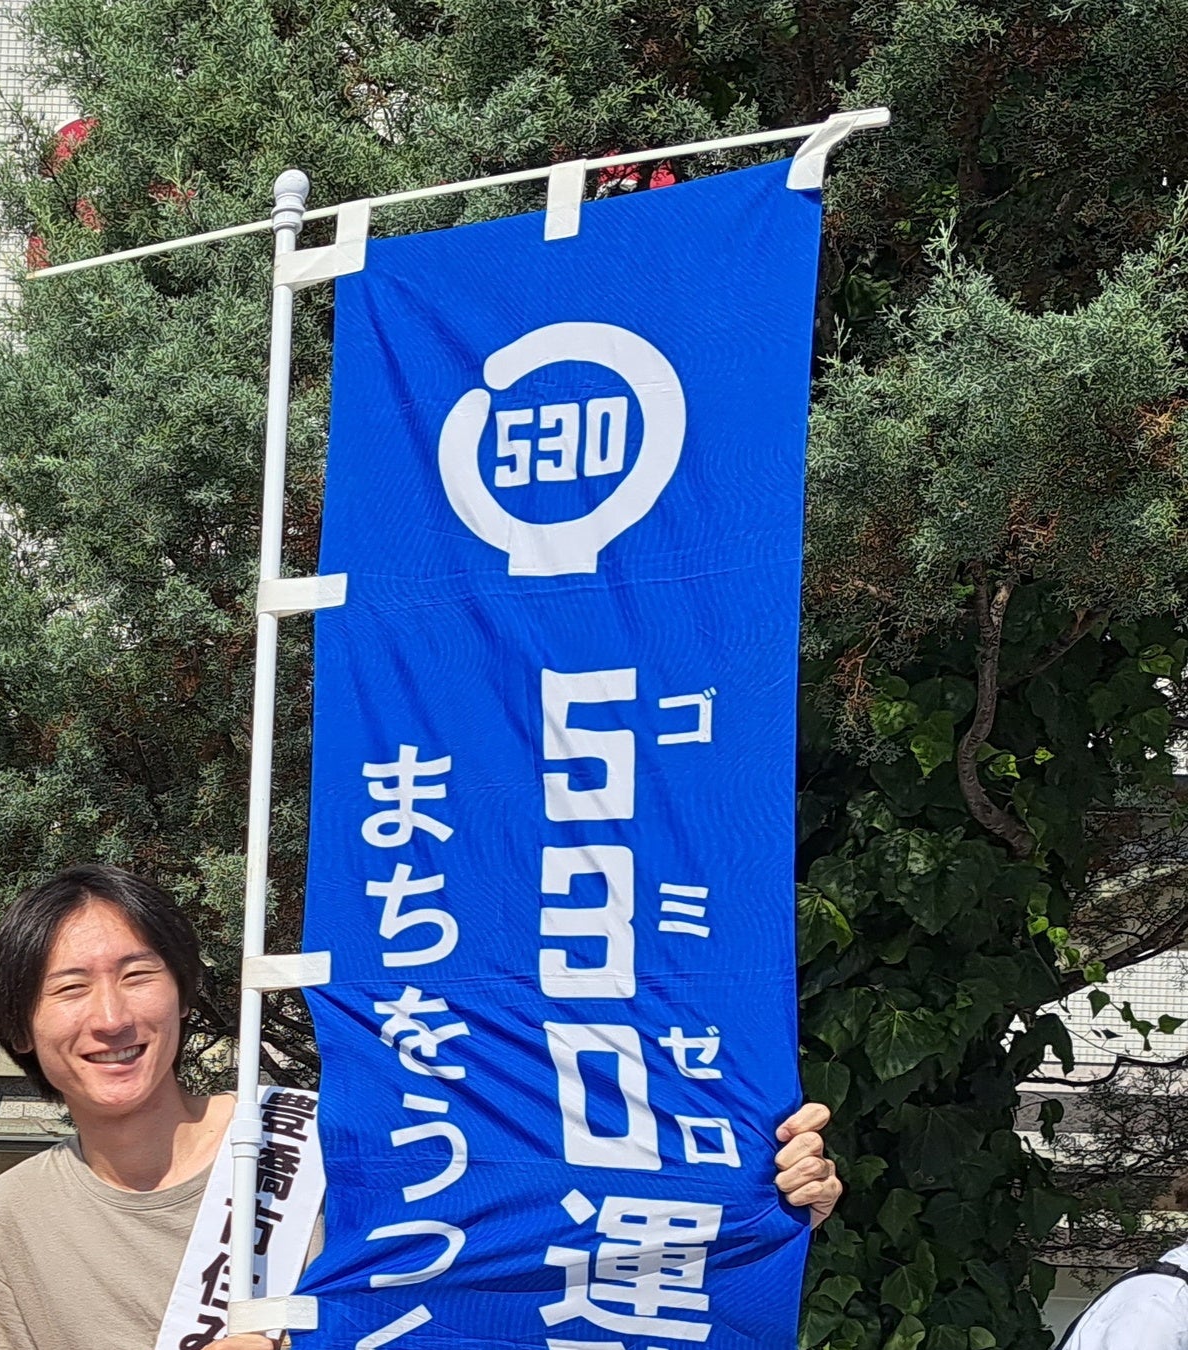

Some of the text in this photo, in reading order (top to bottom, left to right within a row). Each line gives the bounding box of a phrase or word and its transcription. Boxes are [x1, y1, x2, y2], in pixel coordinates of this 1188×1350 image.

[494, 395, 628, 489] 530
[657, 686, 742, 1168] ゴミゼロ
